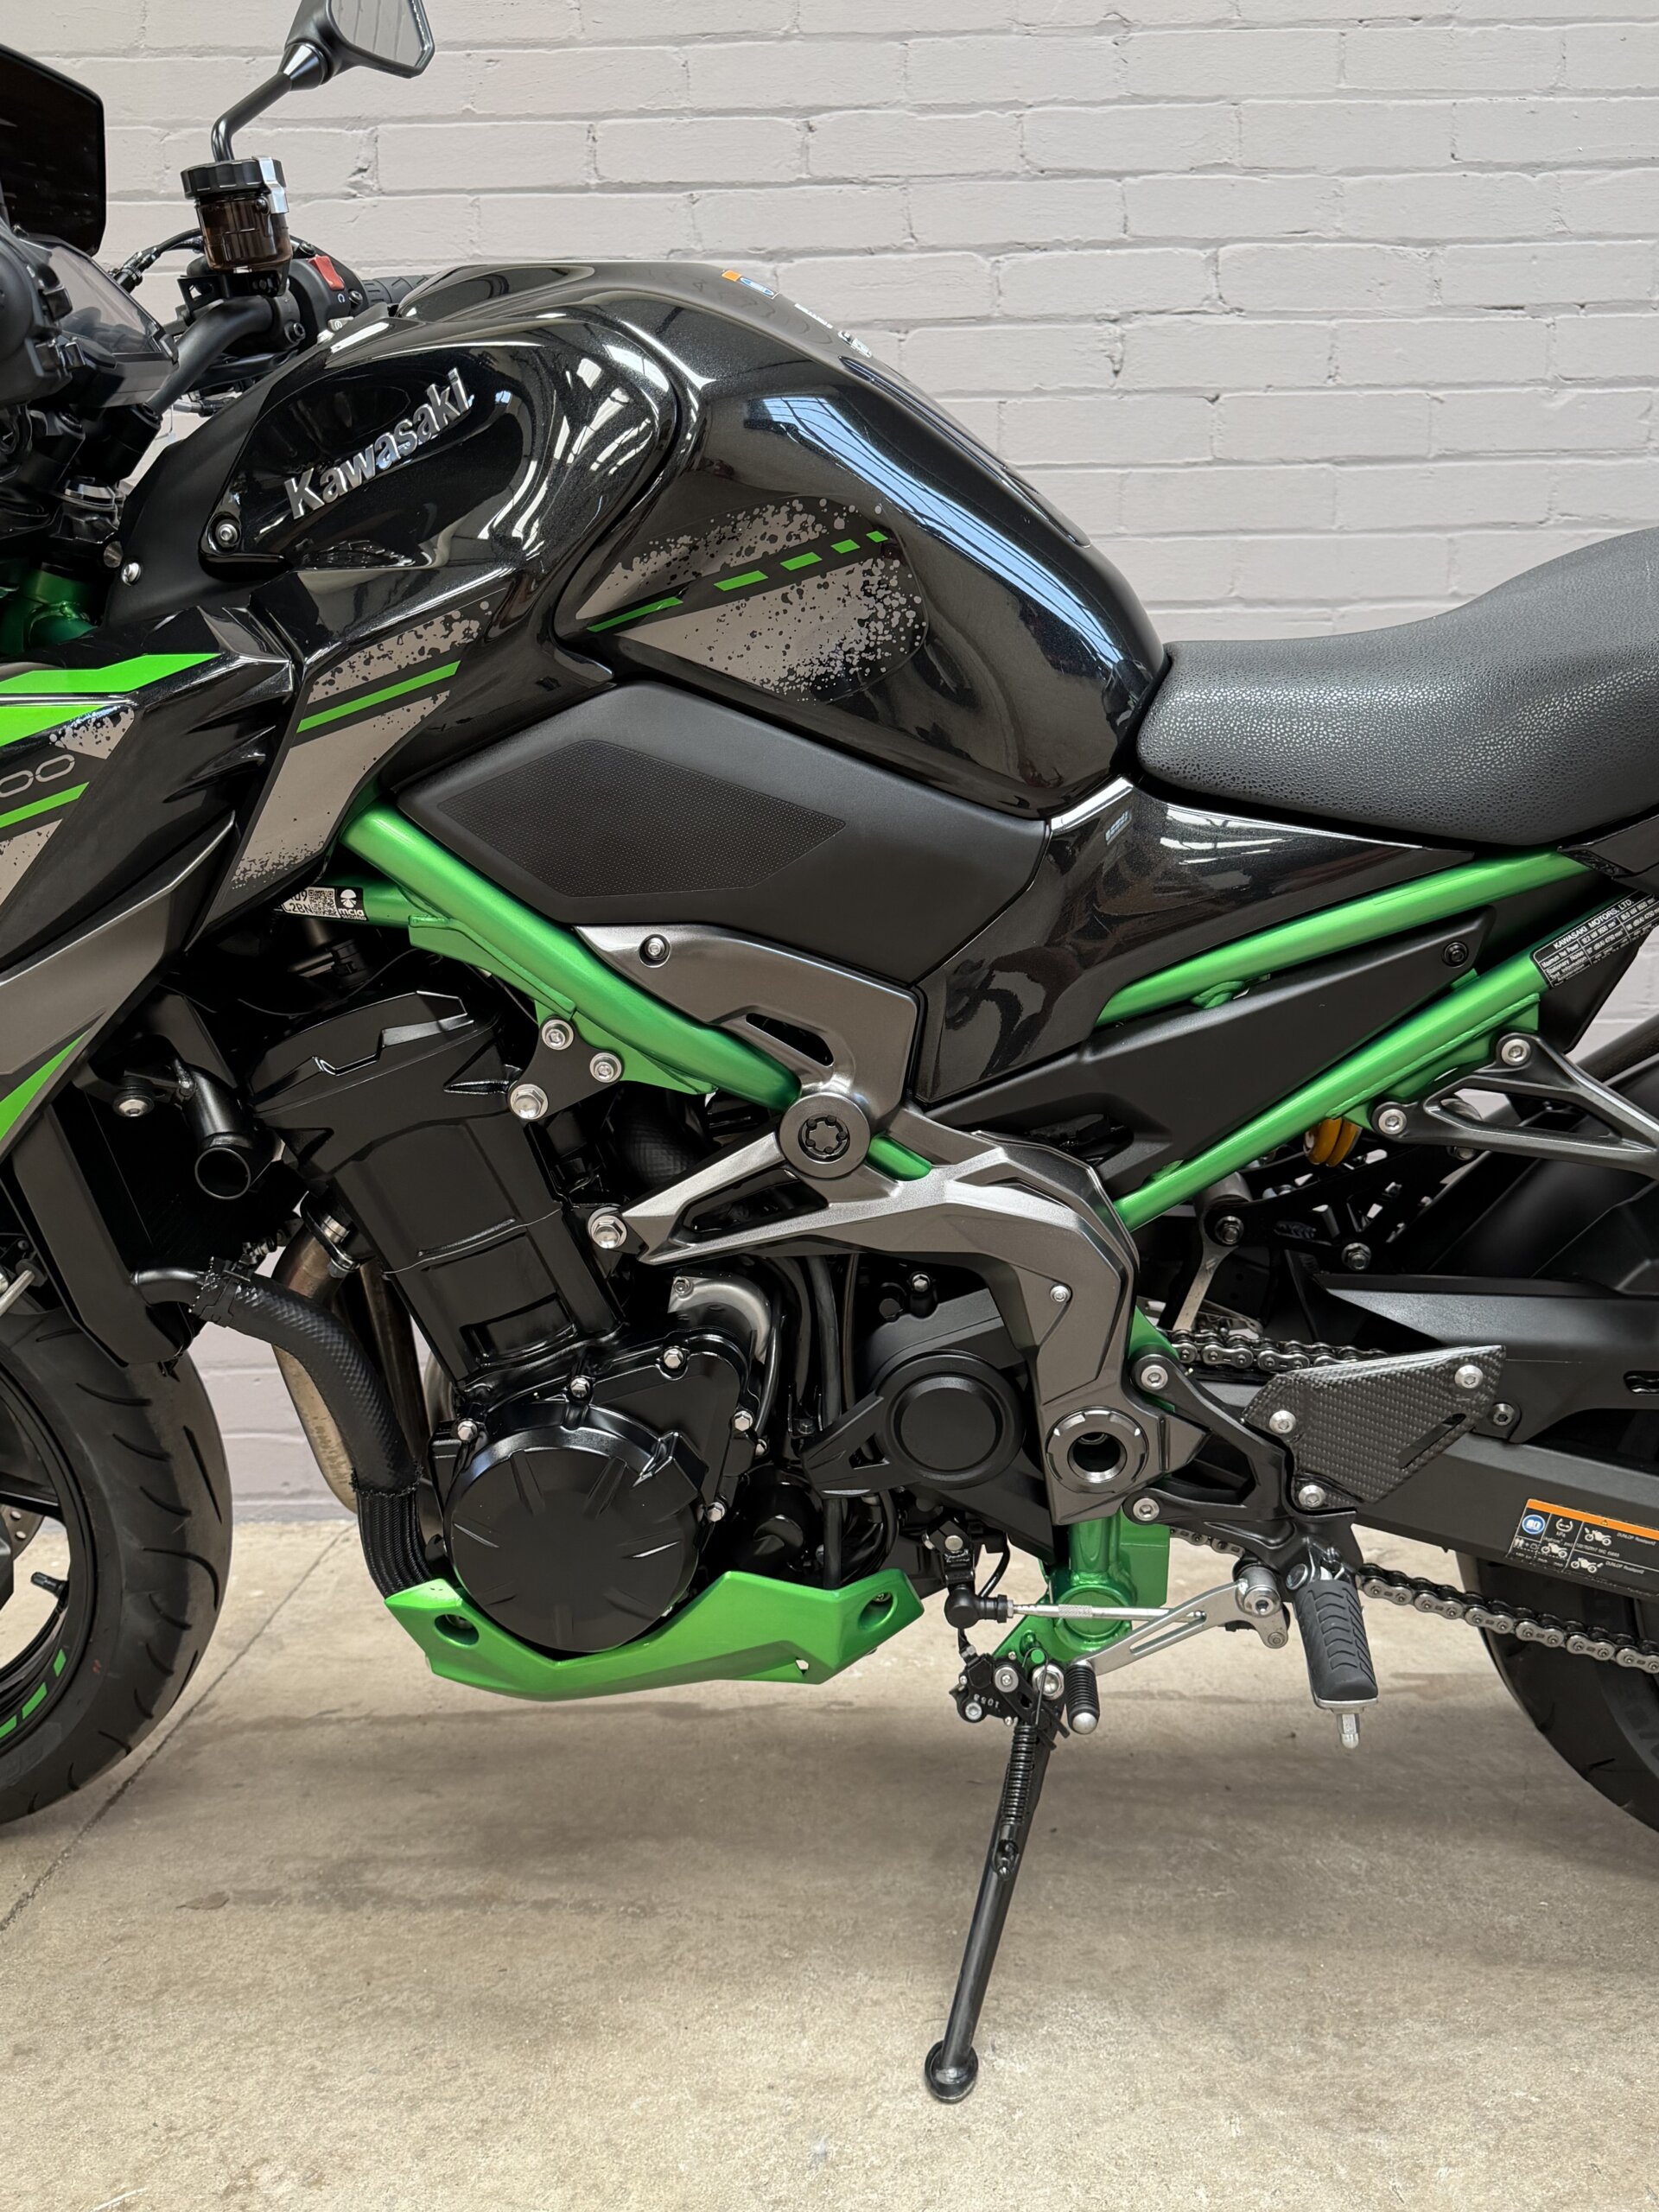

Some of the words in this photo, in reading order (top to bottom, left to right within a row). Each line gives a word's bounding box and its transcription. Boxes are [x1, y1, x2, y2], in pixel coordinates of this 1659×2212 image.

[284, 367, 469, 520] Kawasaki
[338, 908, 365, 917] mcia
[1553, 925, 1587, 948] KAWASAKI
[1588, 906, 1618, 928] MOTORS,
[1618, 898, 1634, 910] LTD.
[1546, 958, 1569, 975] Stationary
[1570, 950, 1584, 960] Noise
